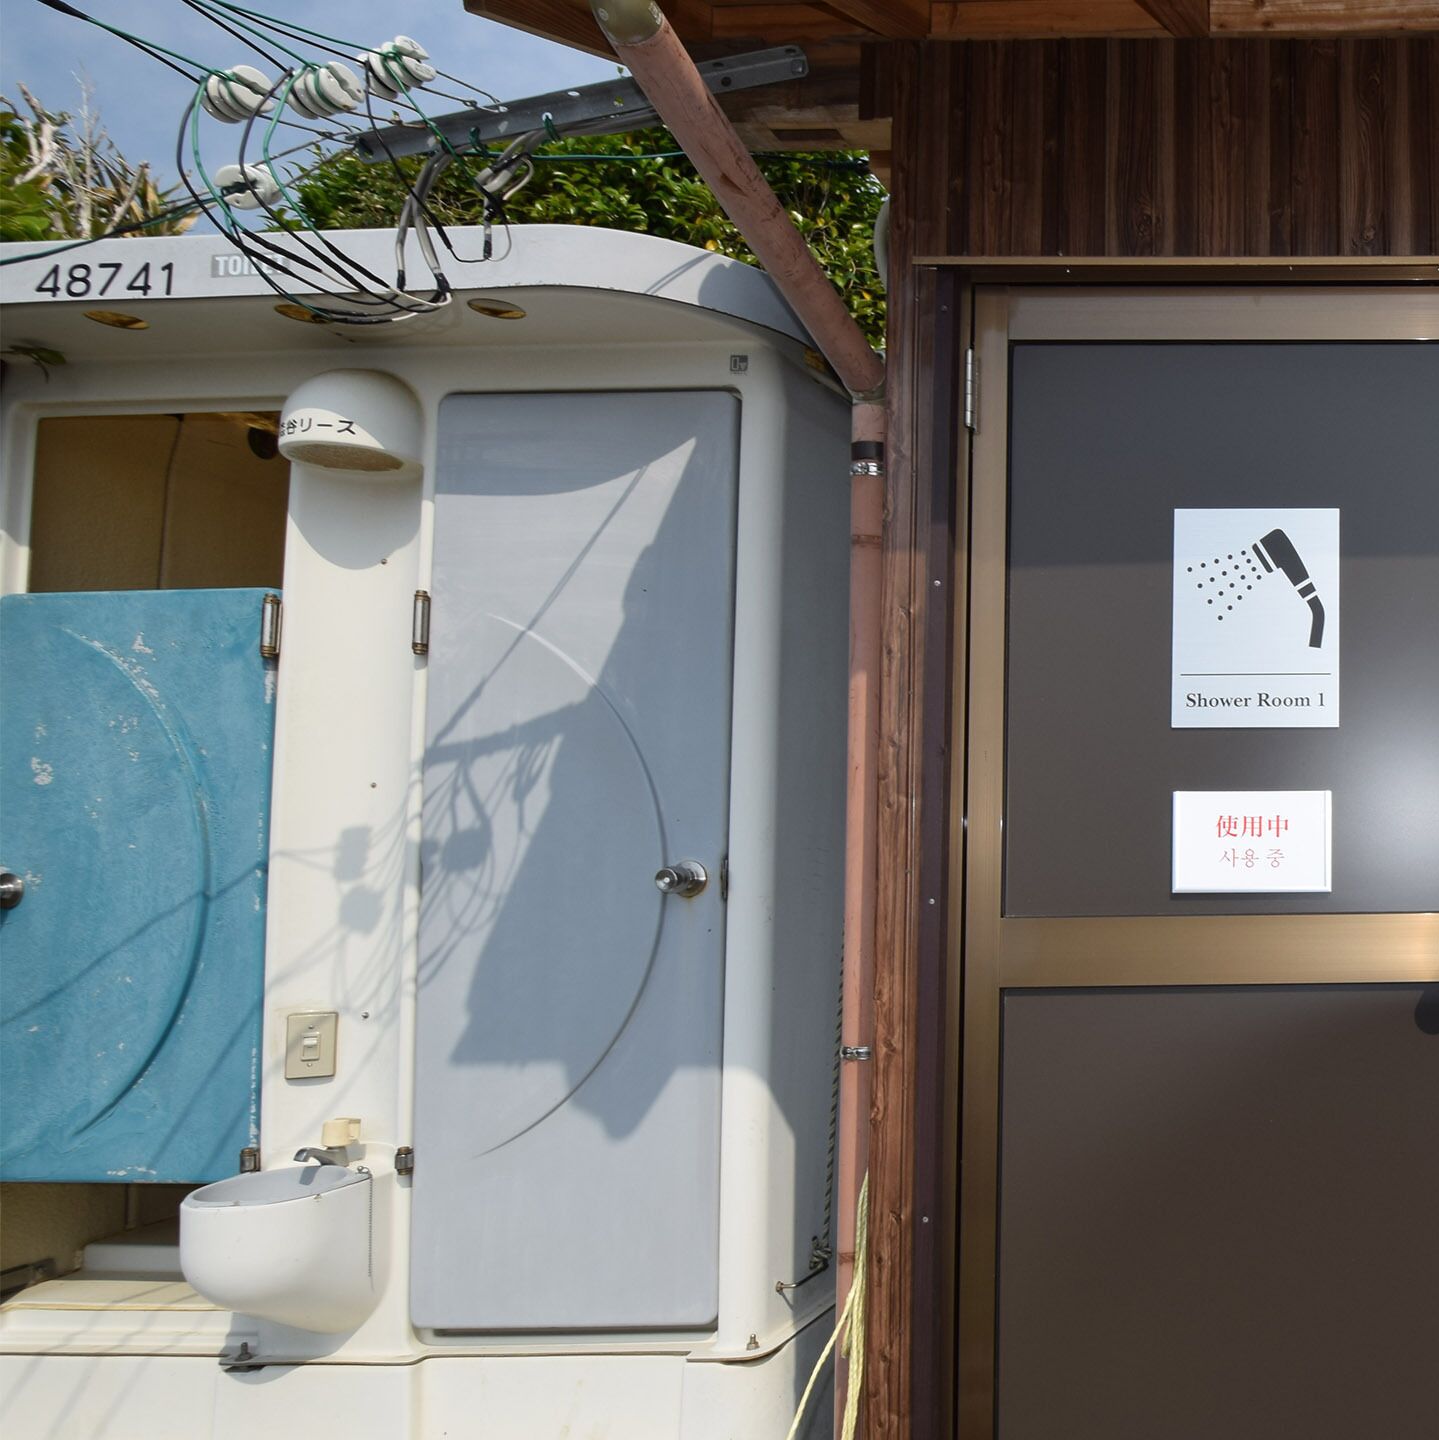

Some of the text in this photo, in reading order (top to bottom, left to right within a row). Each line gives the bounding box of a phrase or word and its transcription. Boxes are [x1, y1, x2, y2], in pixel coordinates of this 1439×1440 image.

[34, 262, 174, 298] 48741
[280, 417, 356, 437] 谷リース
[1186, 692, 1325, 708] Shower Room 1
[1216, 815, 1288, 838] 使用中
[1219, 848, 1285, 868] 사용 중
